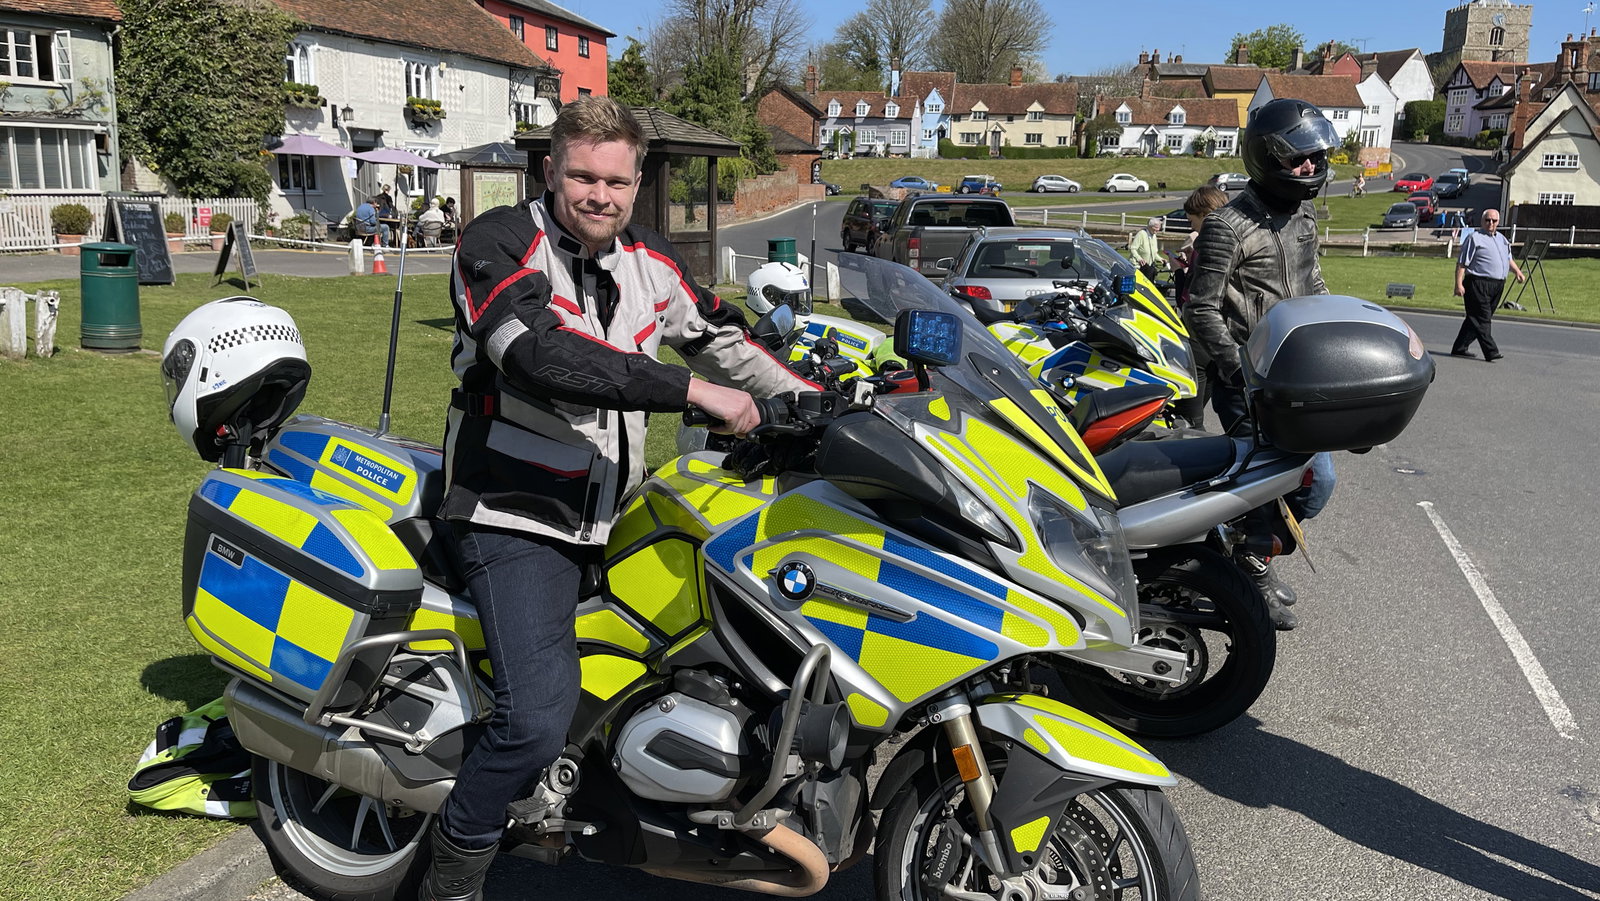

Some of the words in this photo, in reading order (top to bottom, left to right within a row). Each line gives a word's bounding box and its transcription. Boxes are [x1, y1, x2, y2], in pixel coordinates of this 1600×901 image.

[841, 337, 860, 347] POLICE
[532, 364, 627, 393] RST
[354, 455, 399, 480] METROPOLITAN
[356, 465, 389, 486] POLICE
[217, 543, 236, 560] BMW
[783, 563, 814, 581] BMW
[932, 842, 952, 879] brembo
